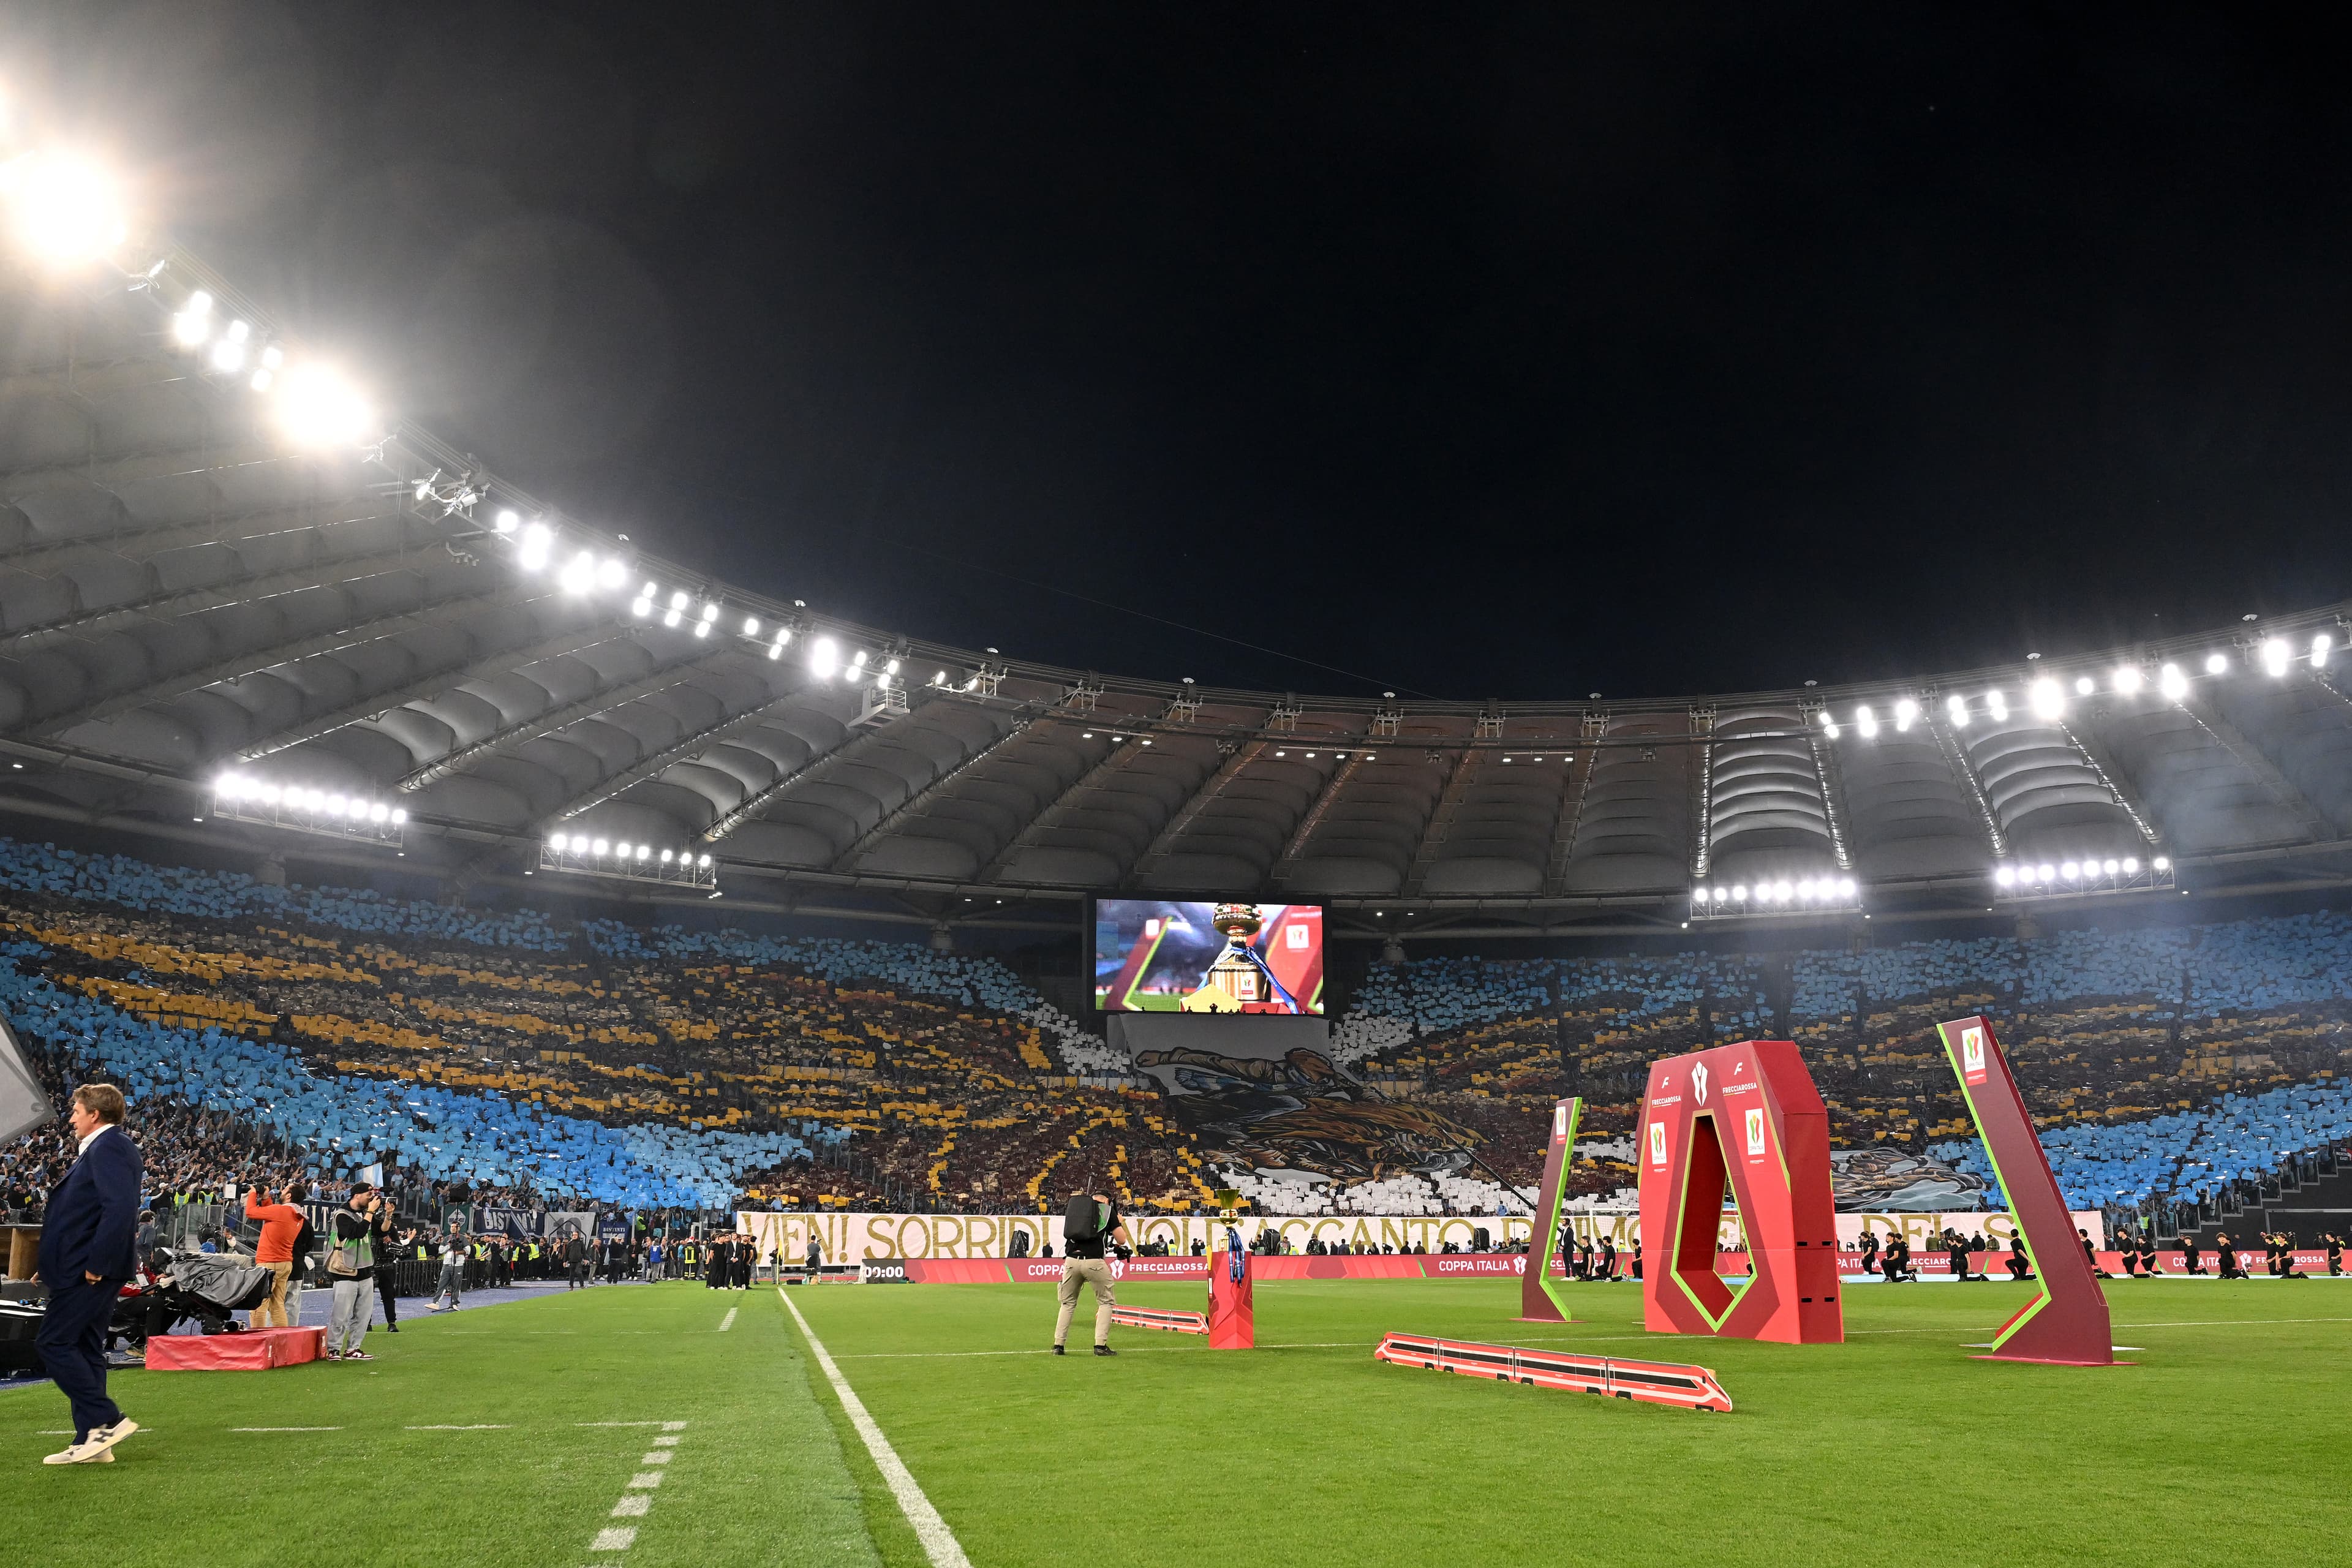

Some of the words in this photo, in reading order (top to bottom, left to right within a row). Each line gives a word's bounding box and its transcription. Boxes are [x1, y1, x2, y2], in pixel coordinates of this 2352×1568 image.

[1722, 1082, 1757, 1094] FRECCIAROSSA
[1652, 1095, 1681, 1106] FRECCIAROSSA
[864, 1215, 1050, 1259] SORRIDI
[865, 1266, 904, 1278] 00:00
[1028, 1264, 1065, 1276] COPPA
[1129, 1262, 1208, 1272] FRECCIAROSSA
[1439, 1261, 1474, 1272] COPPA
[1477, 1260, 1510, 1271] ITALIA
